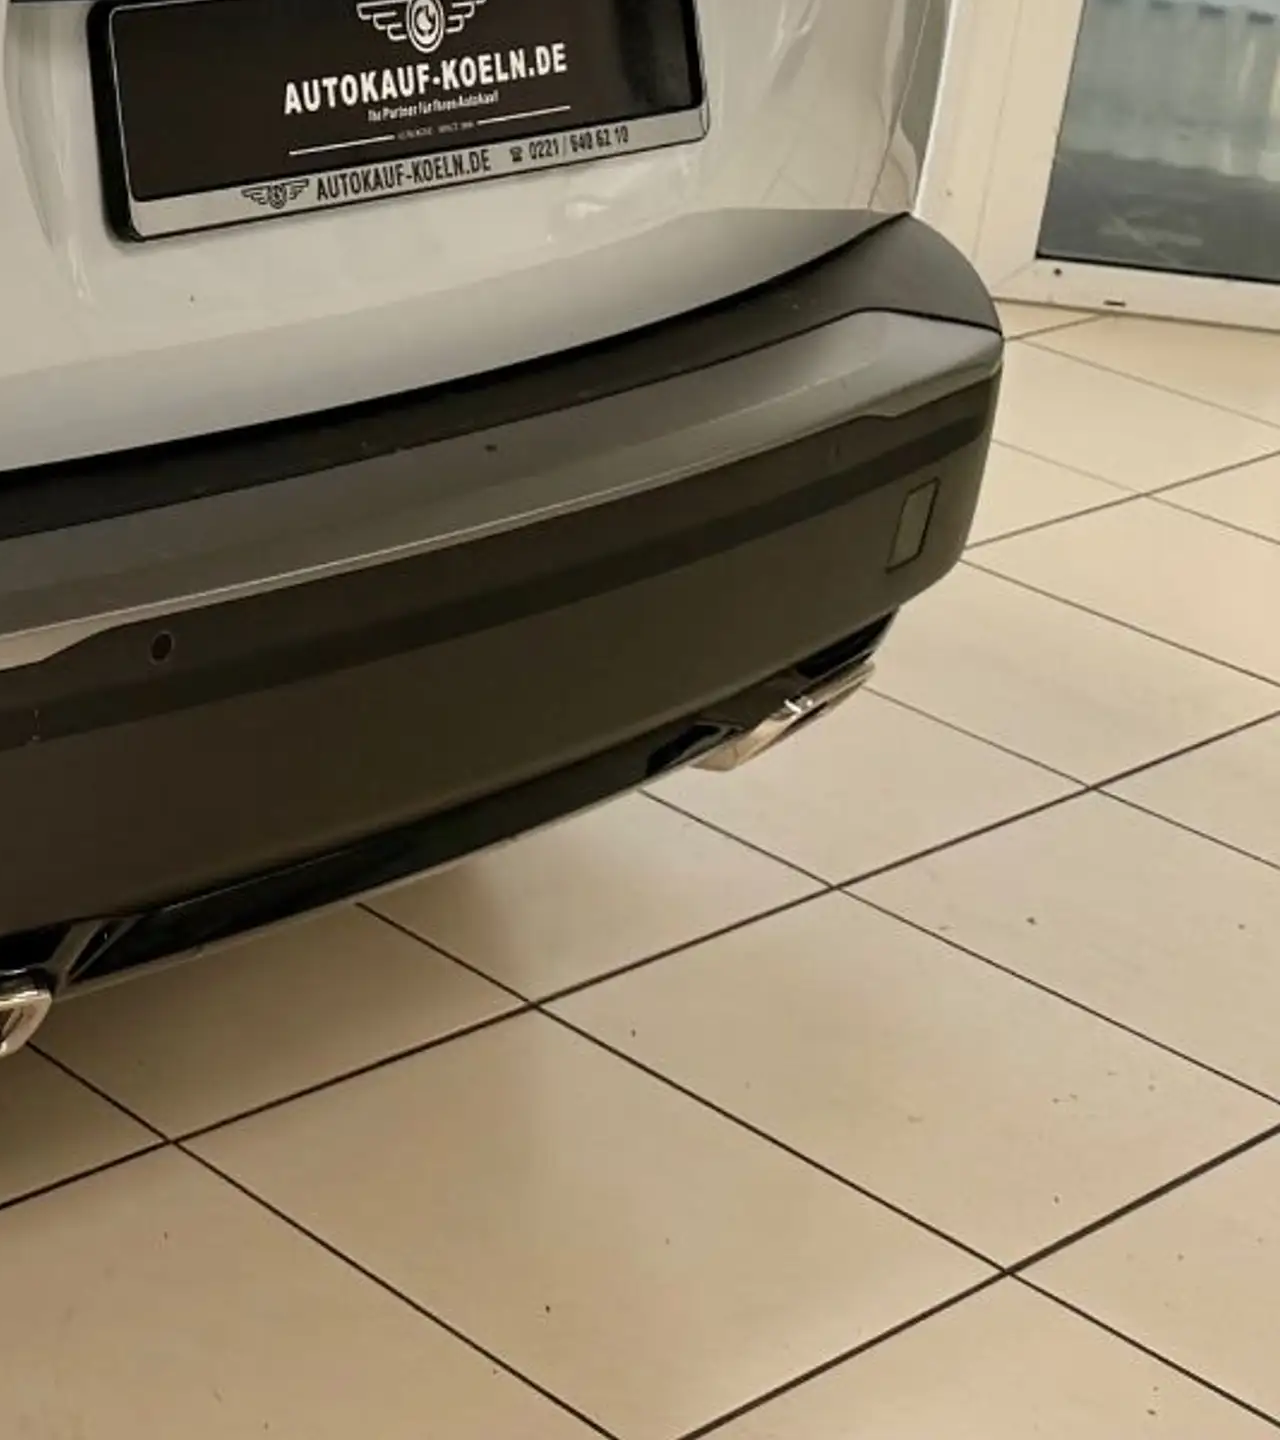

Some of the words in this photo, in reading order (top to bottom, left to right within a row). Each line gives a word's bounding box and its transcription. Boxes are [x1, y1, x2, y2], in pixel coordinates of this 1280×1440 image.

[284, 42, 568, 114] AUTOKAUF-KOELN.DE
[316, 148, 491, 201] AUTOKAUF-KOELN.DE
[528, 137, 559, 160] 0221
